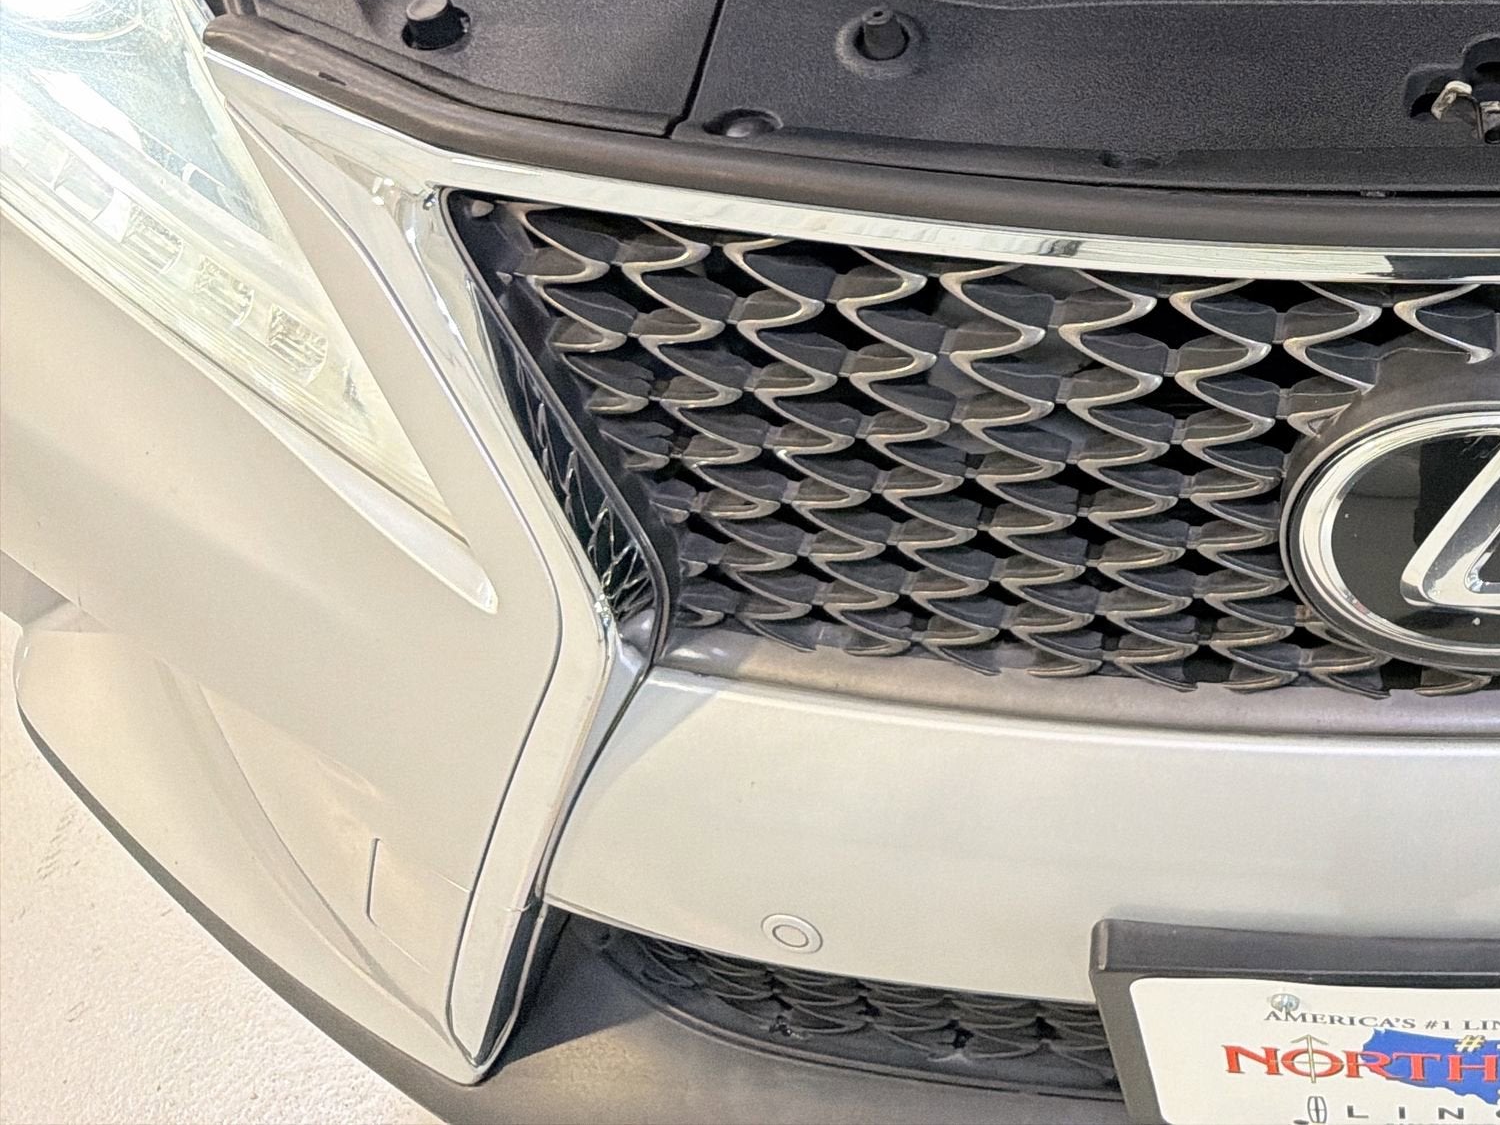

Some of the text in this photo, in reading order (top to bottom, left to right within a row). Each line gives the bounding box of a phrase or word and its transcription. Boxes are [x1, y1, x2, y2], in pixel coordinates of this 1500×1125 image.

[1264, 1010, 1417, 1029] AMERICA'S
[1424, 1019, 1451, 1030] #1
[1222, 1044, 1498, 1082] NORTH
